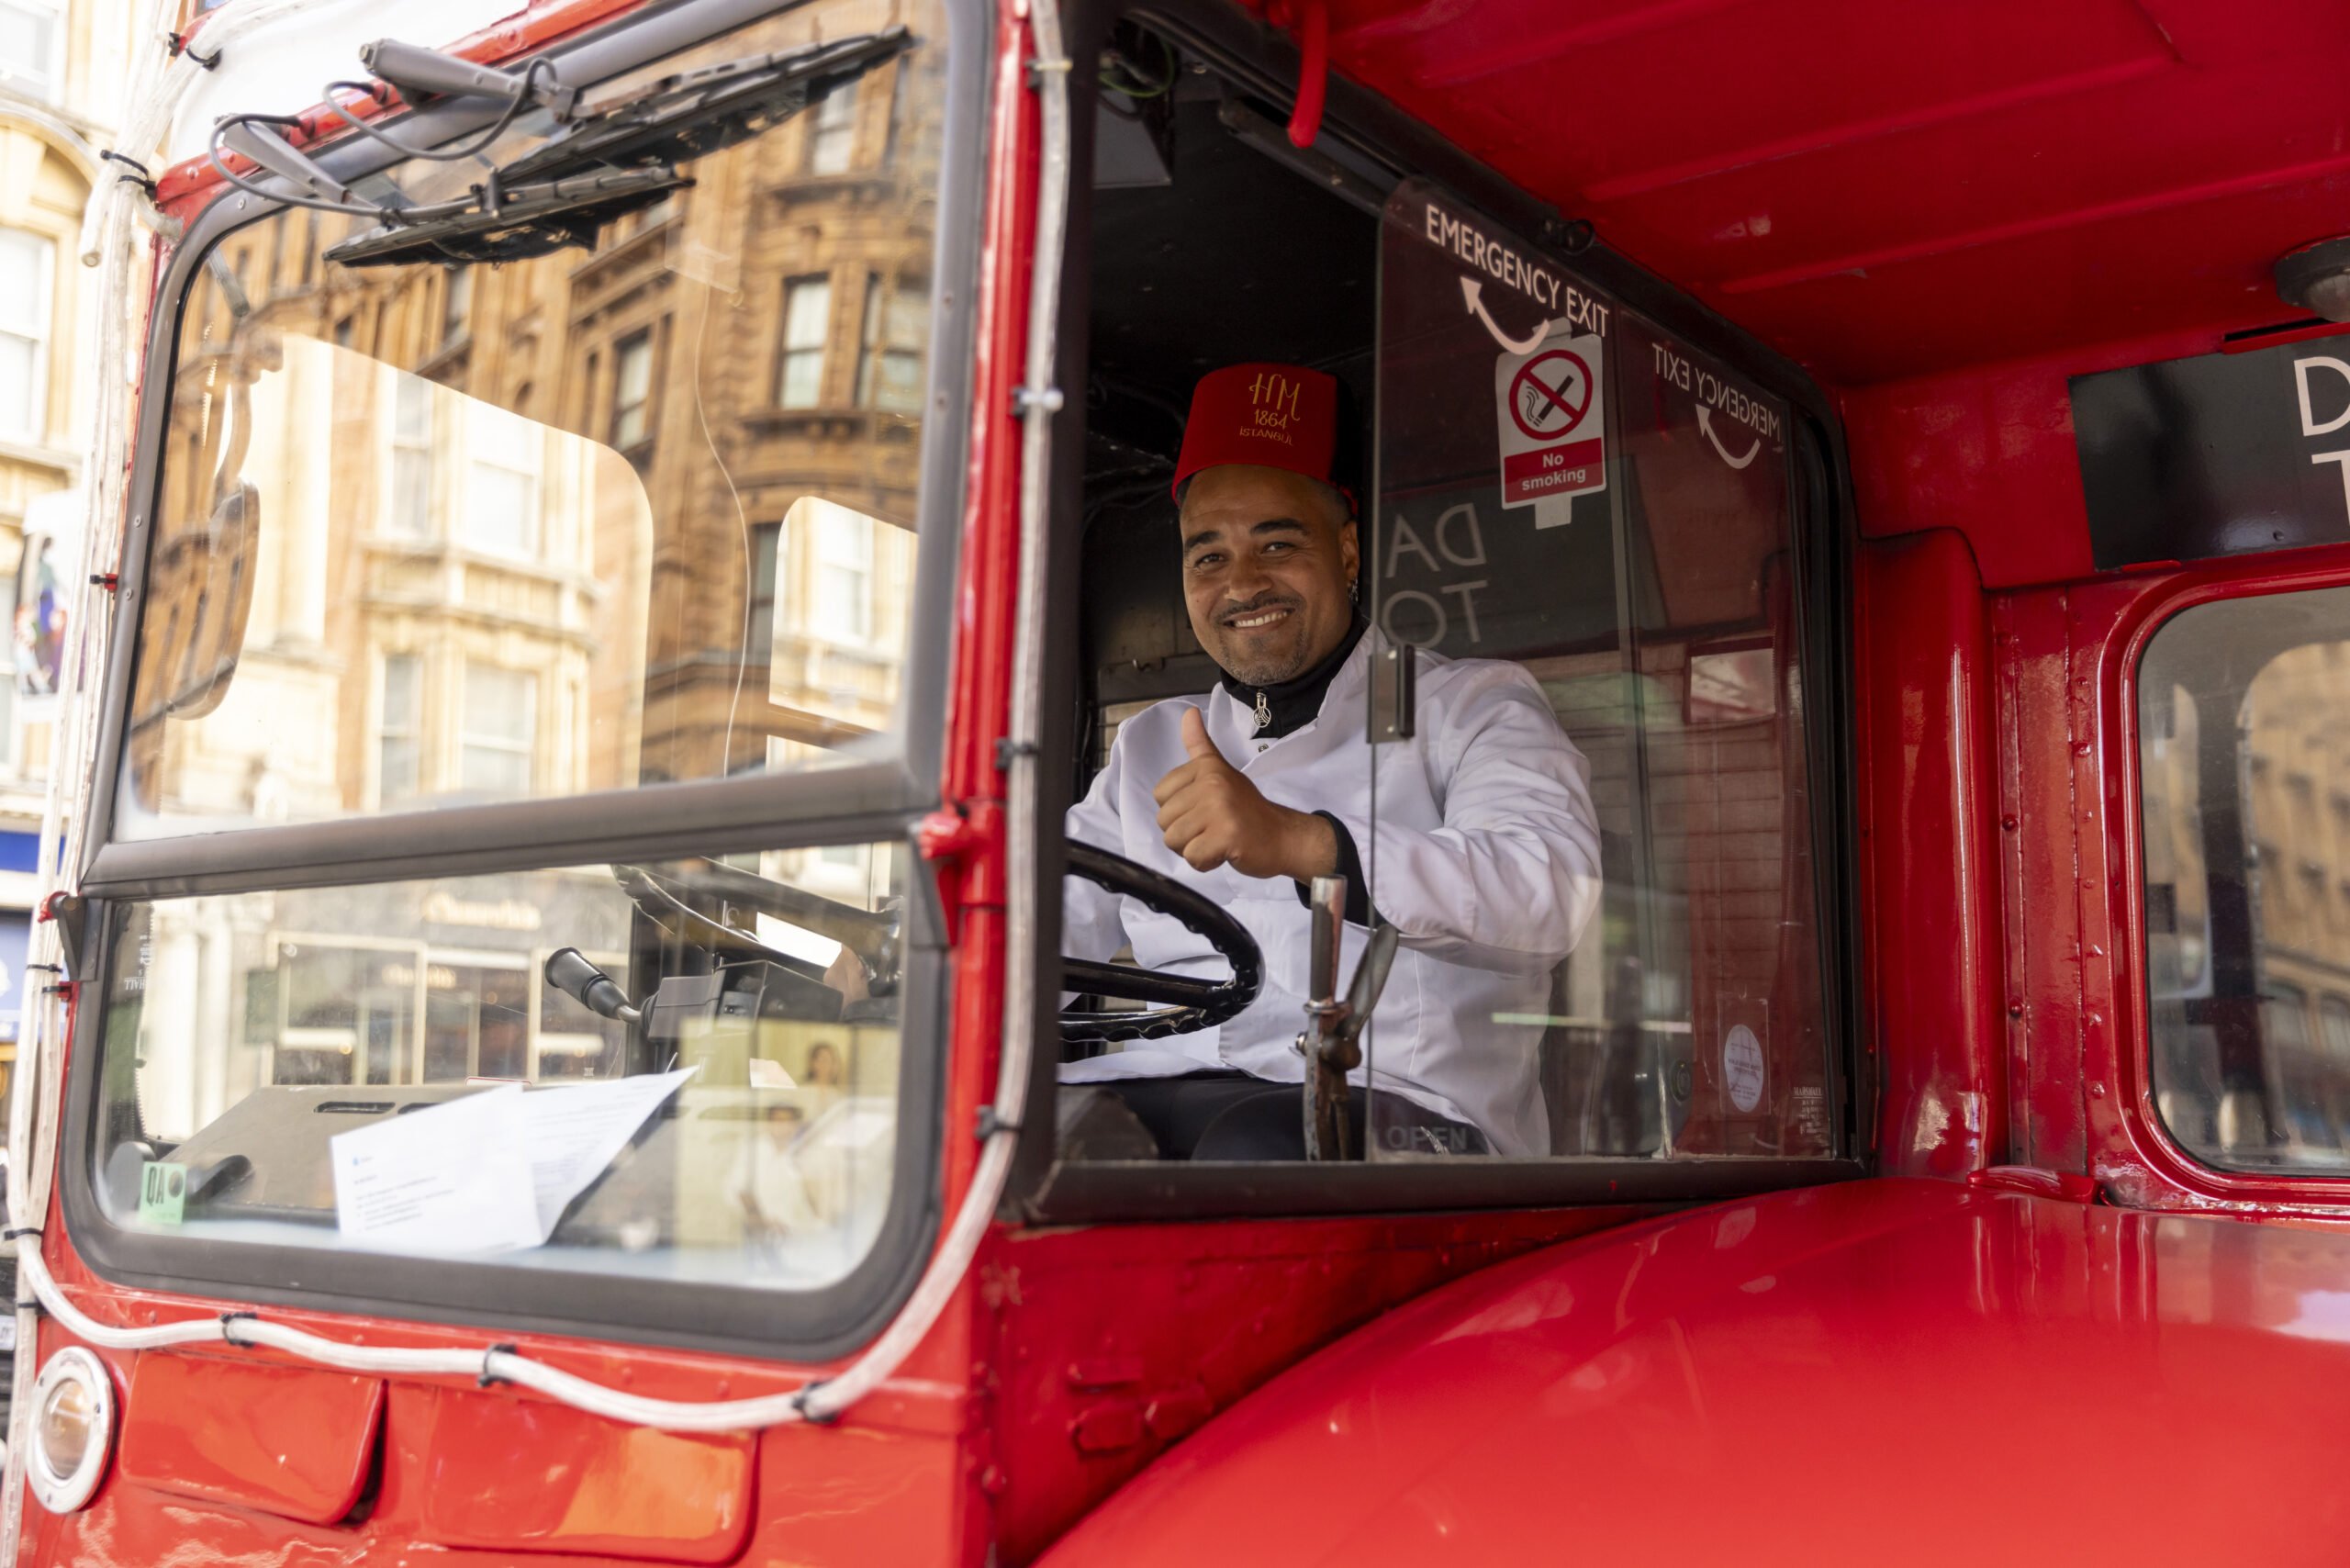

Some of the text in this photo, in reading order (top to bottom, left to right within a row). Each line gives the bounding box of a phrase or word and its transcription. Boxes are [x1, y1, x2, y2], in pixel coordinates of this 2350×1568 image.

[1426, 203, 1609, 338] EMERGENCY EXIT
[1248, 373, 1301, 421] HM
[1253, 409, 1288, 430] 1864
[1542, 453, 1564, 468] No
[1522, 468, 1586, 491] smoking
[1385, 1125, 1468, 1151] OPEN
